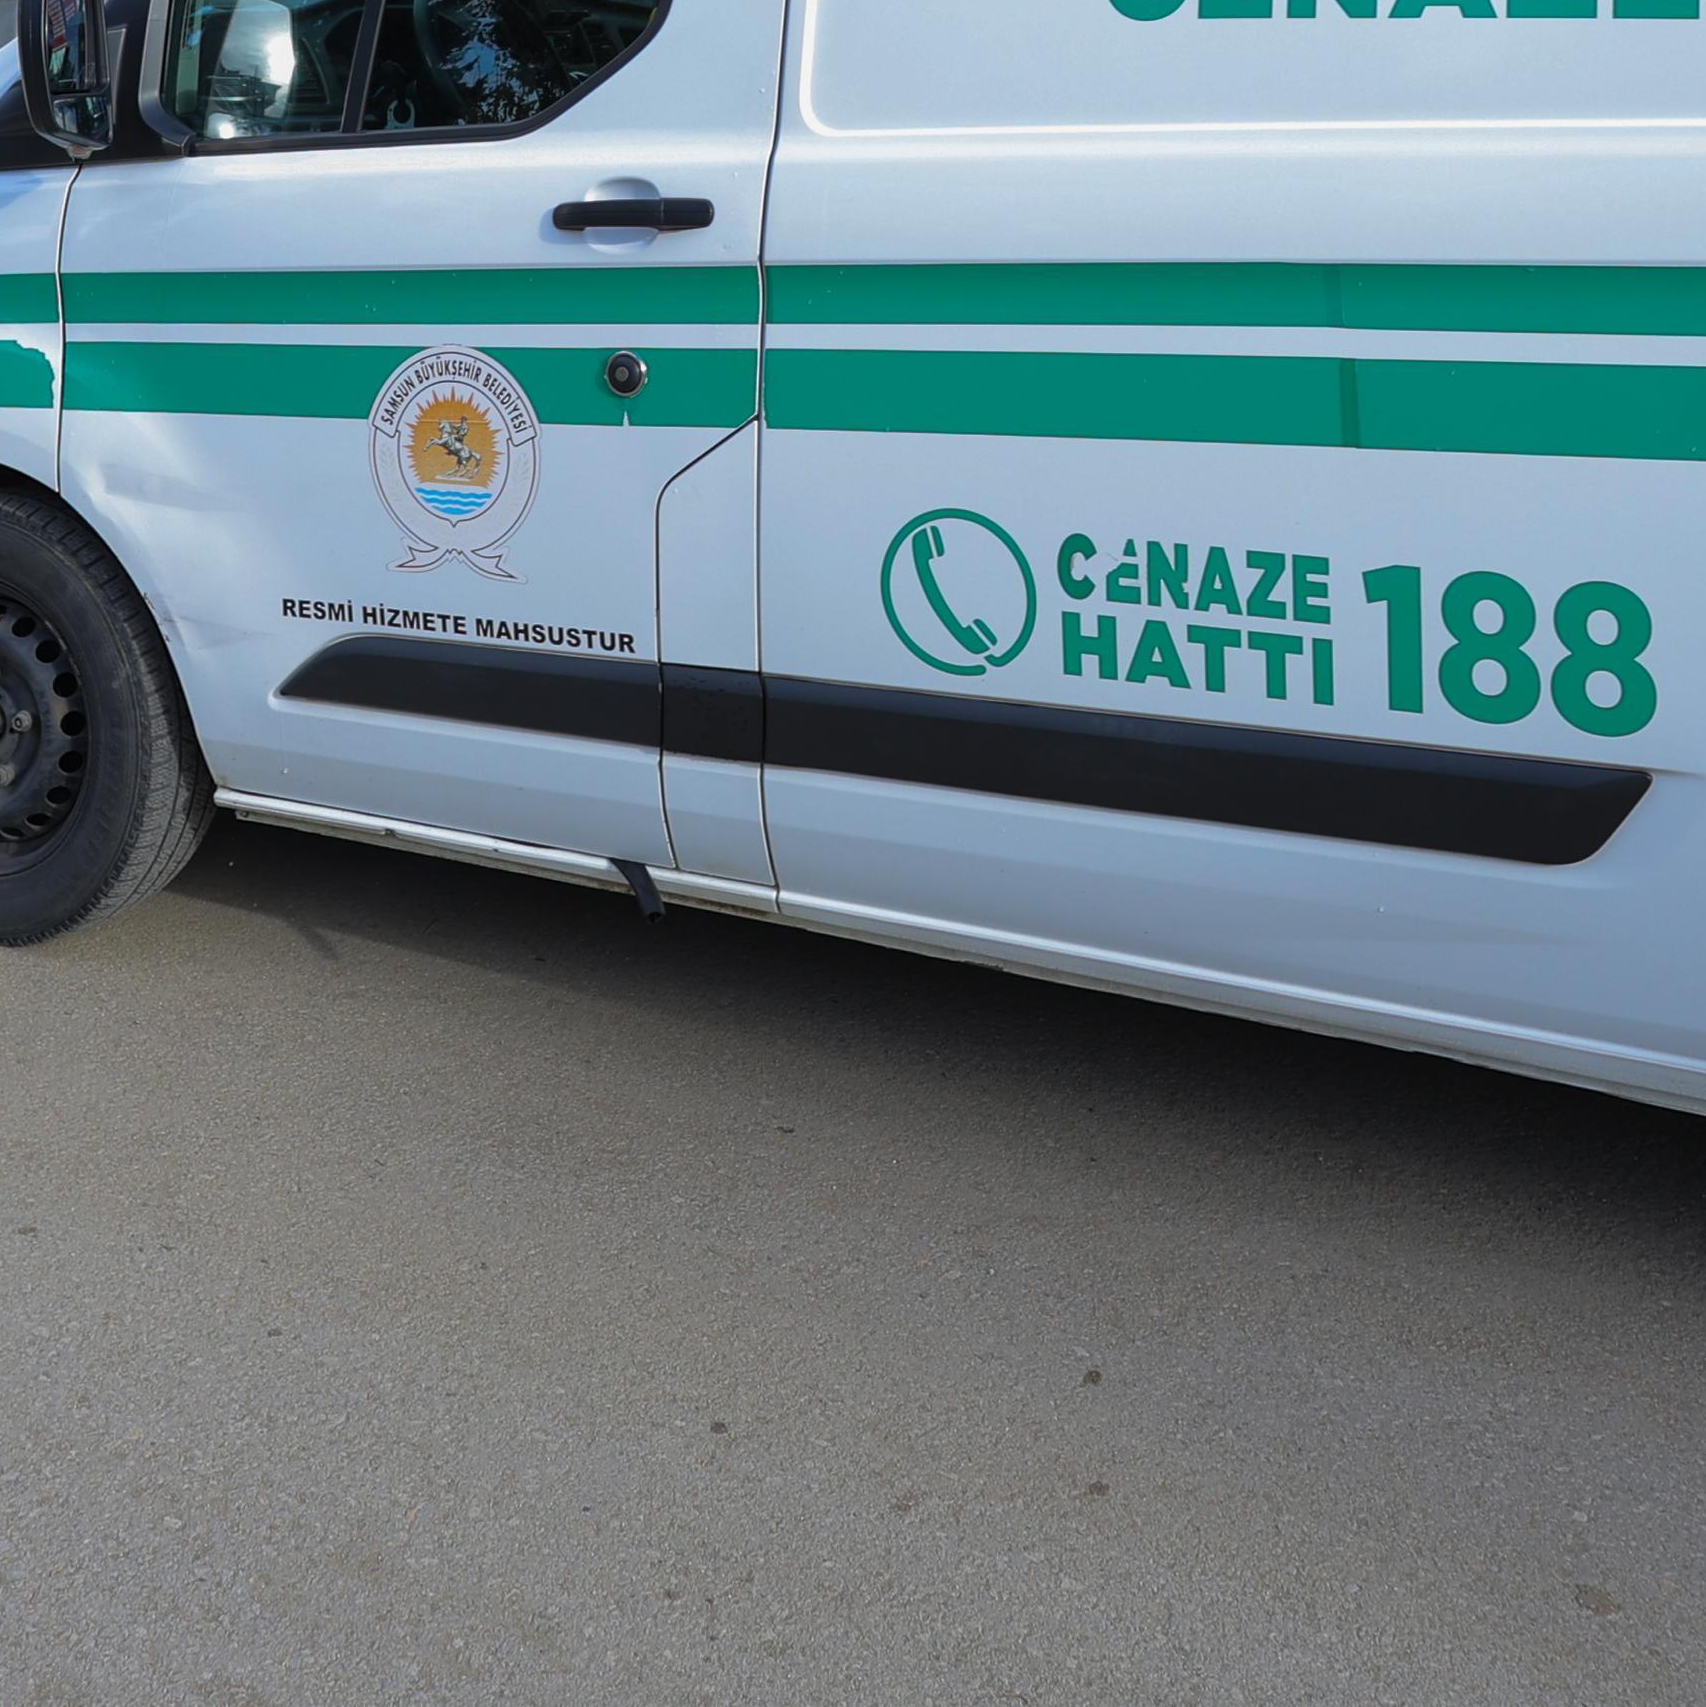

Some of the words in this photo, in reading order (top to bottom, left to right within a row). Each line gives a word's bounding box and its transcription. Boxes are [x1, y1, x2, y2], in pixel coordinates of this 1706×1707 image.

[381, 376, 417, 425] SAMSUN
[413, 355, 483, 384] BÜYÜKŞEHİR
[481, 372, 533, 434] BELEDİYESİ
[1057, 533, 1332, 625] CENAZE
[282, 598, 355, 623] RESMİ
[362, 602, 467, 635] HİZMETE
[475, 617, 637, 654] MAHSUSTUR
[1061, 610, 1335, 706] HATTI
[1362, 565, 1659, 738] 188
